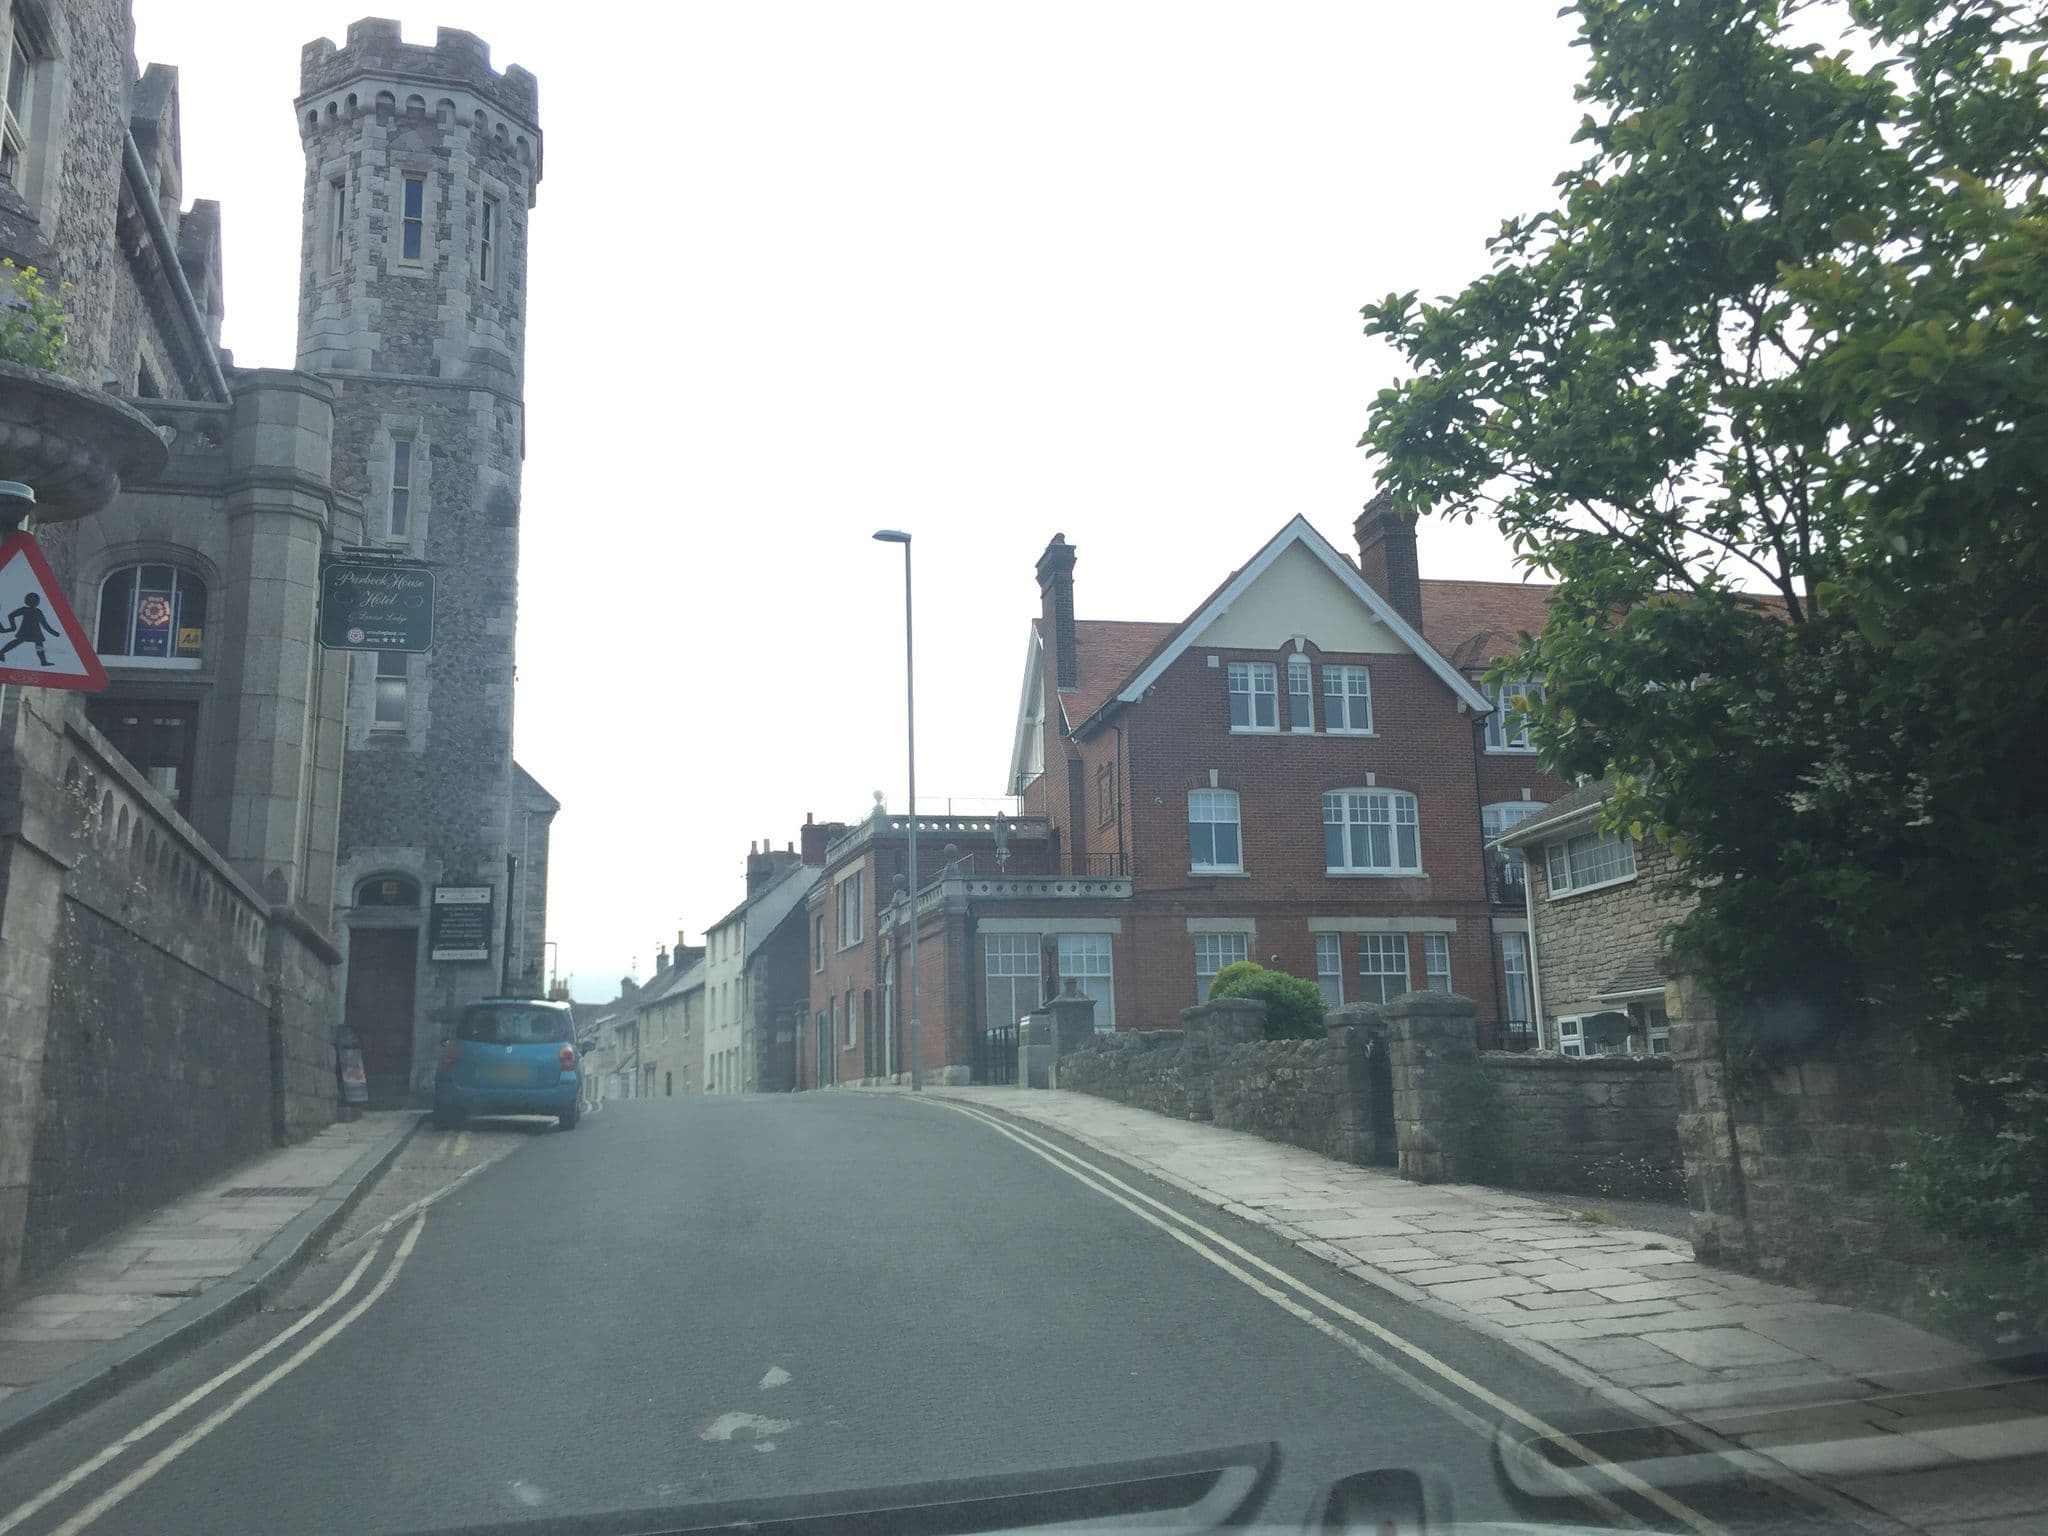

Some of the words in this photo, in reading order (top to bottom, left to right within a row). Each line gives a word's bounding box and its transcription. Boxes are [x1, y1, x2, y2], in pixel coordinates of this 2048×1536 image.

[334, 570, 388, 586] Purbeck
[389, 573, 424, 590] House
[360, 591, 398, 608] Hotel
